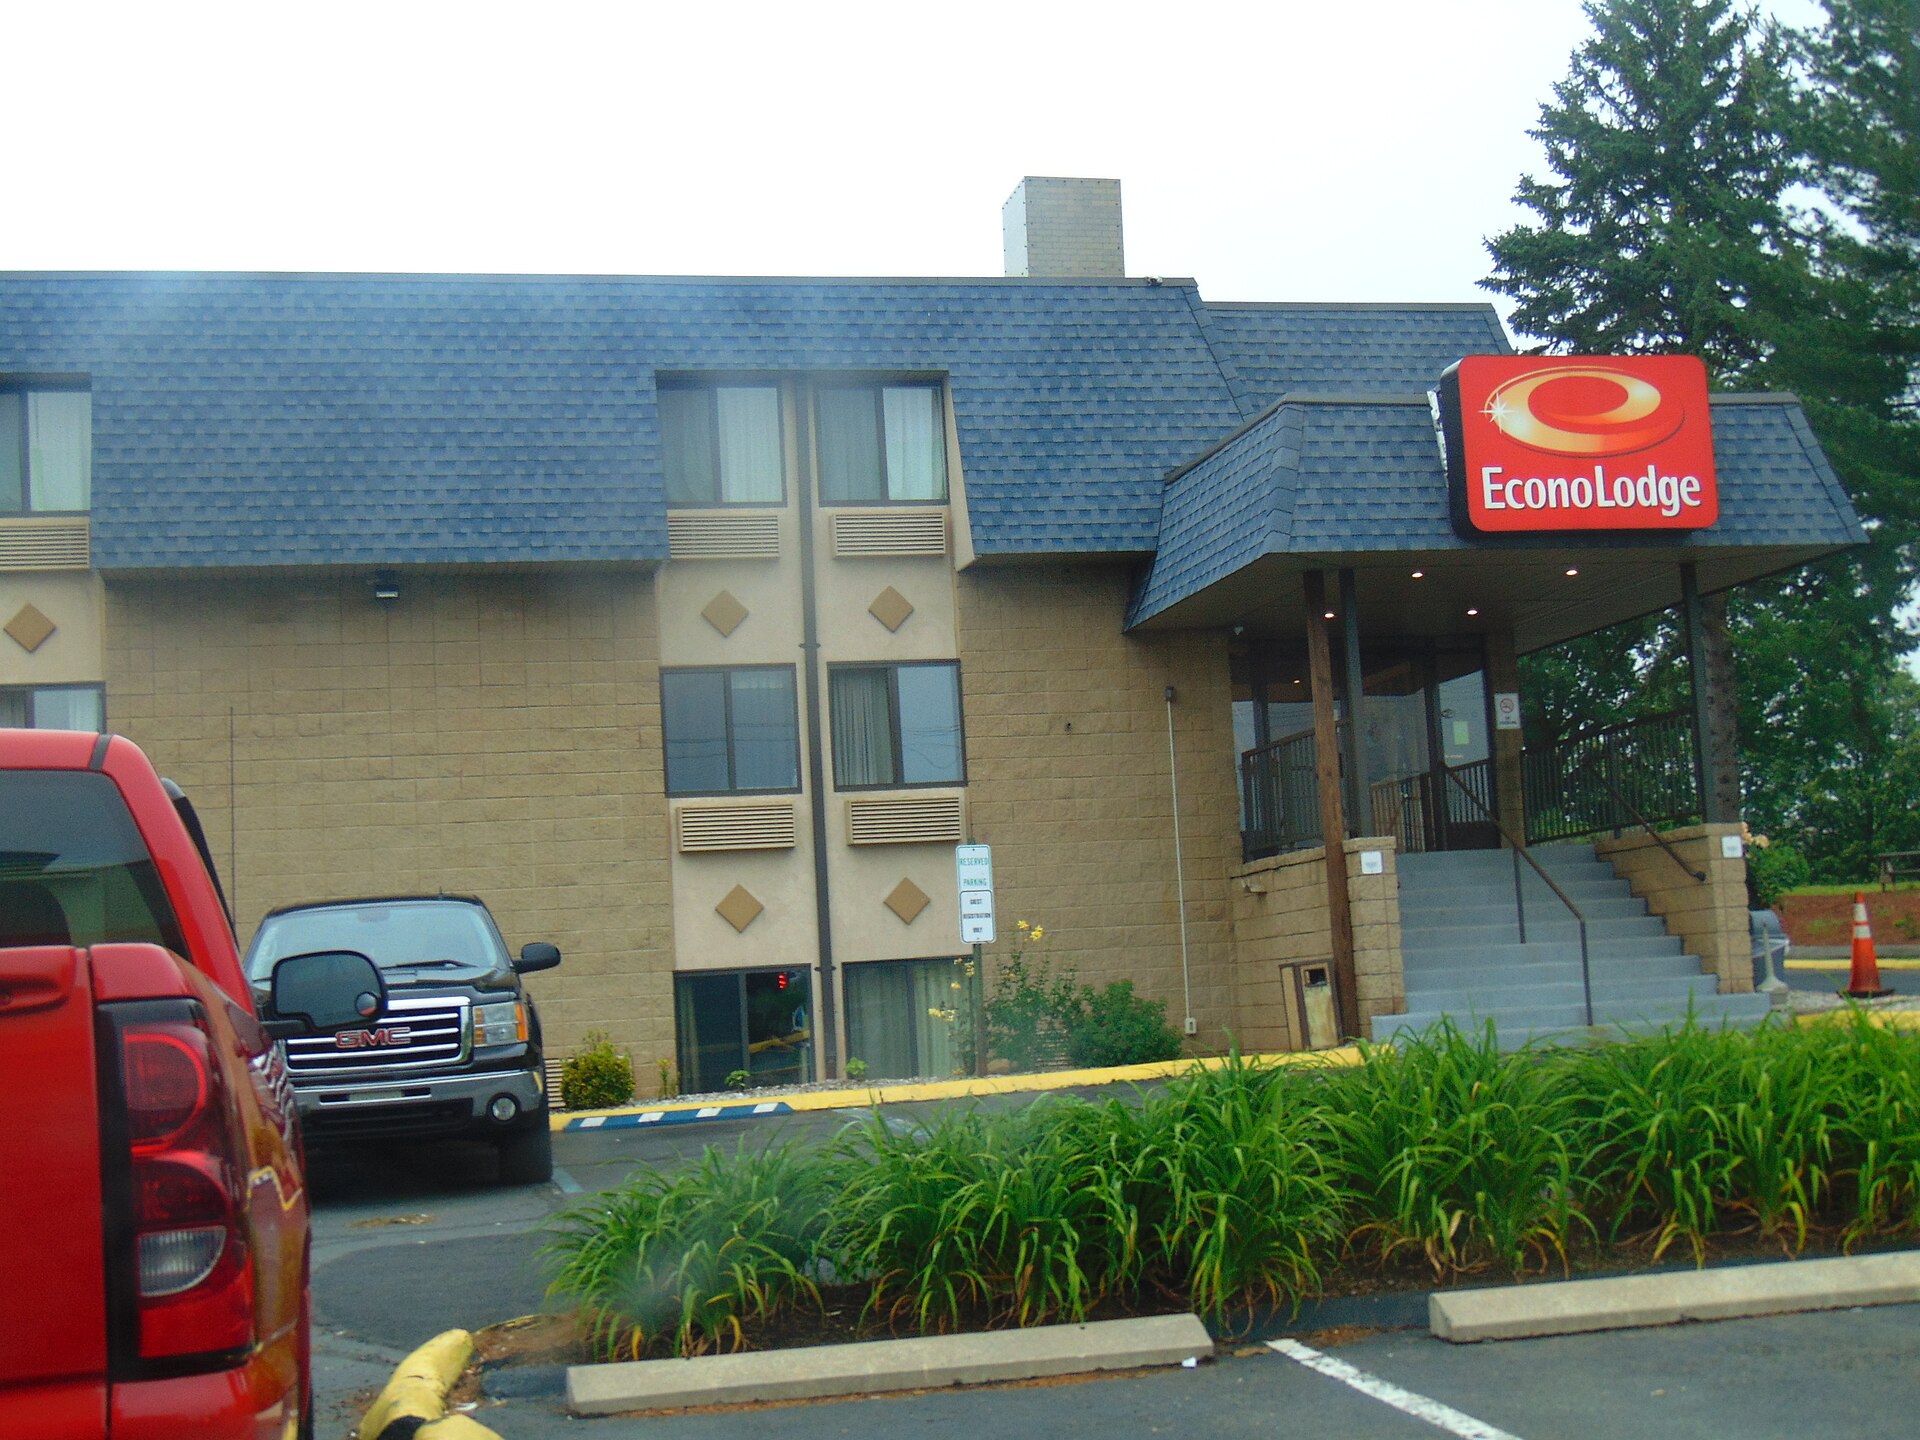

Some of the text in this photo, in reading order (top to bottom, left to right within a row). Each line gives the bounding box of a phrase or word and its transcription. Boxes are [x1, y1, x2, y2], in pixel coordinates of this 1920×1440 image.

[1481, 465, 1702, 517] EconoLodge
[960, 857, 989, 866] RESERVED
[963, 878, 987, 886] PARKING
[335, 1026, 411, 1048] GMC
